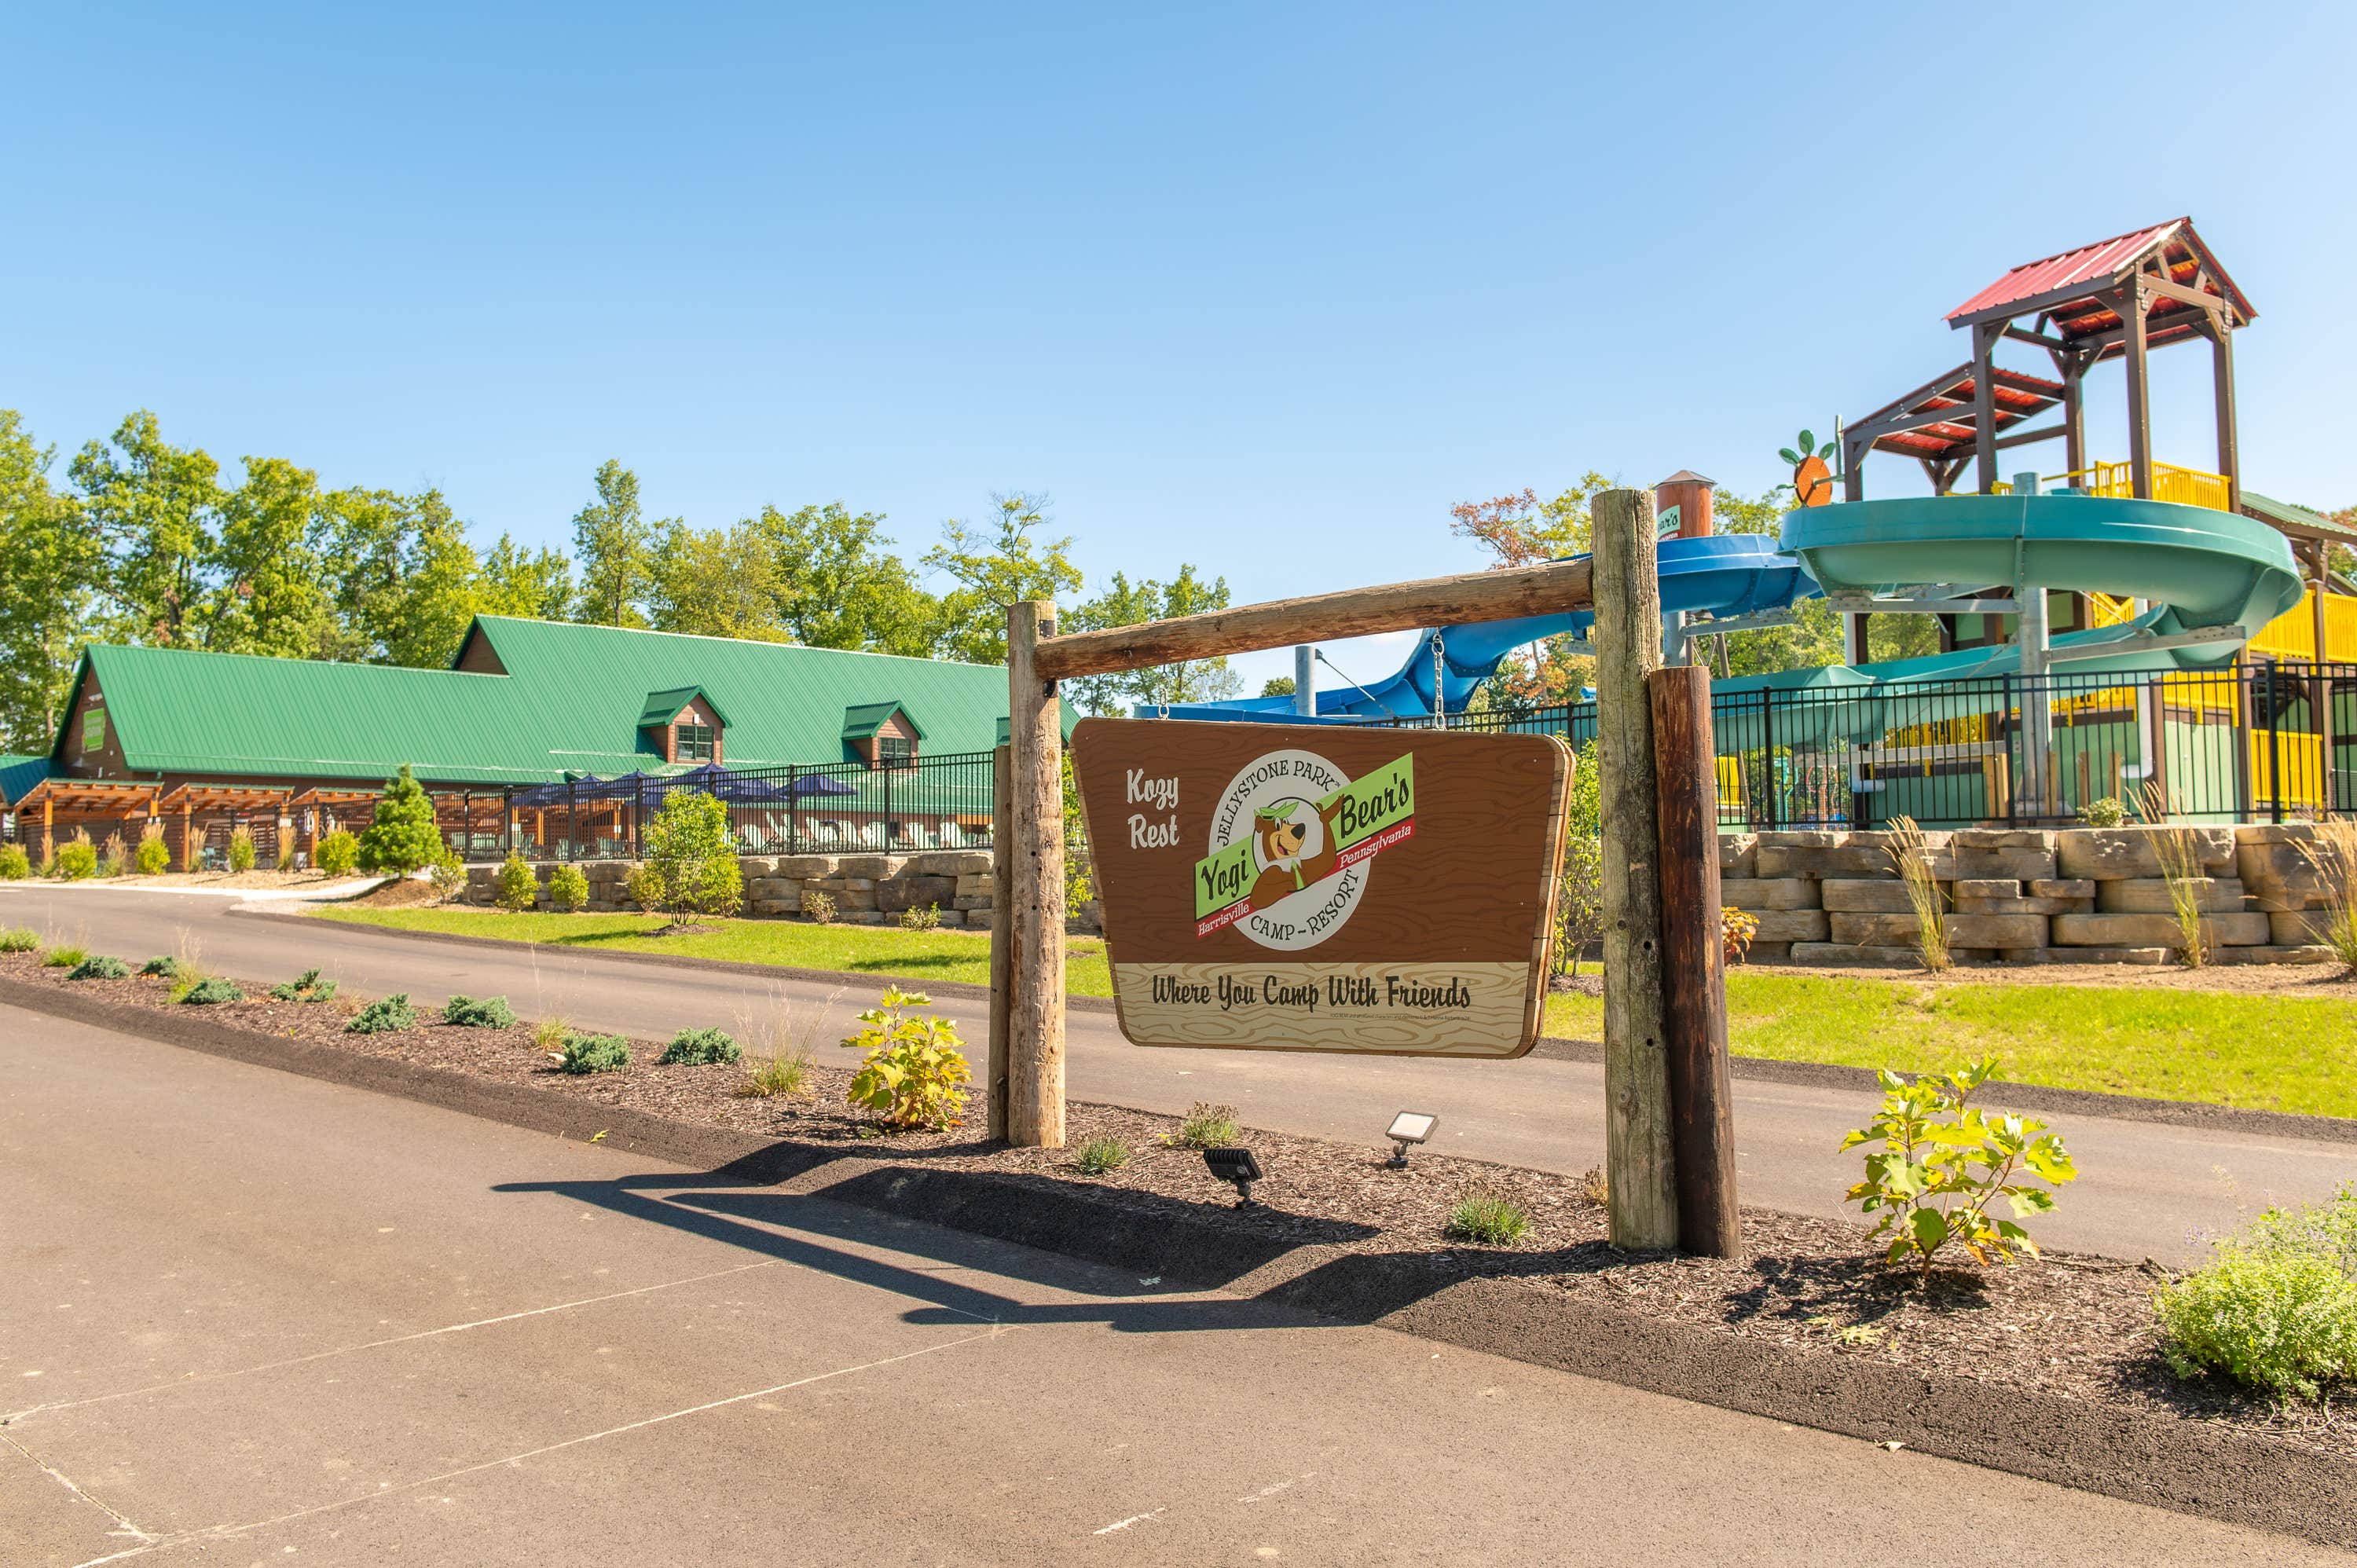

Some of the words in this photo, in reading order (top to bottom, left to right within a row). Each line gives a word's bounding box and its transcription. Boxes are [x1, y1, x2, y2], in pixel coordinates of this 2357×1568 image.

[1126, 768, 1178, 810] Kozy
[1217, 760, 1288, 847] JELLYSTONE
[1127, 814, 1179, 849] Rest
[1200, 849, 1249, 900] Yogi
[1340, 772, 1409, 839] Bear's
[1198, 903, 1249, 936] Harrisville
[1340, 825, 1411, 869] Pennsylvania
[1153, 974, 1211, 1004] Where
[1218, 974, 1257, 1011] You
[1263, 975, 1319, 1013] Camp
[1328, 975, 1379, 1007] With
[1385, 975, 1471, 1008] Friends
